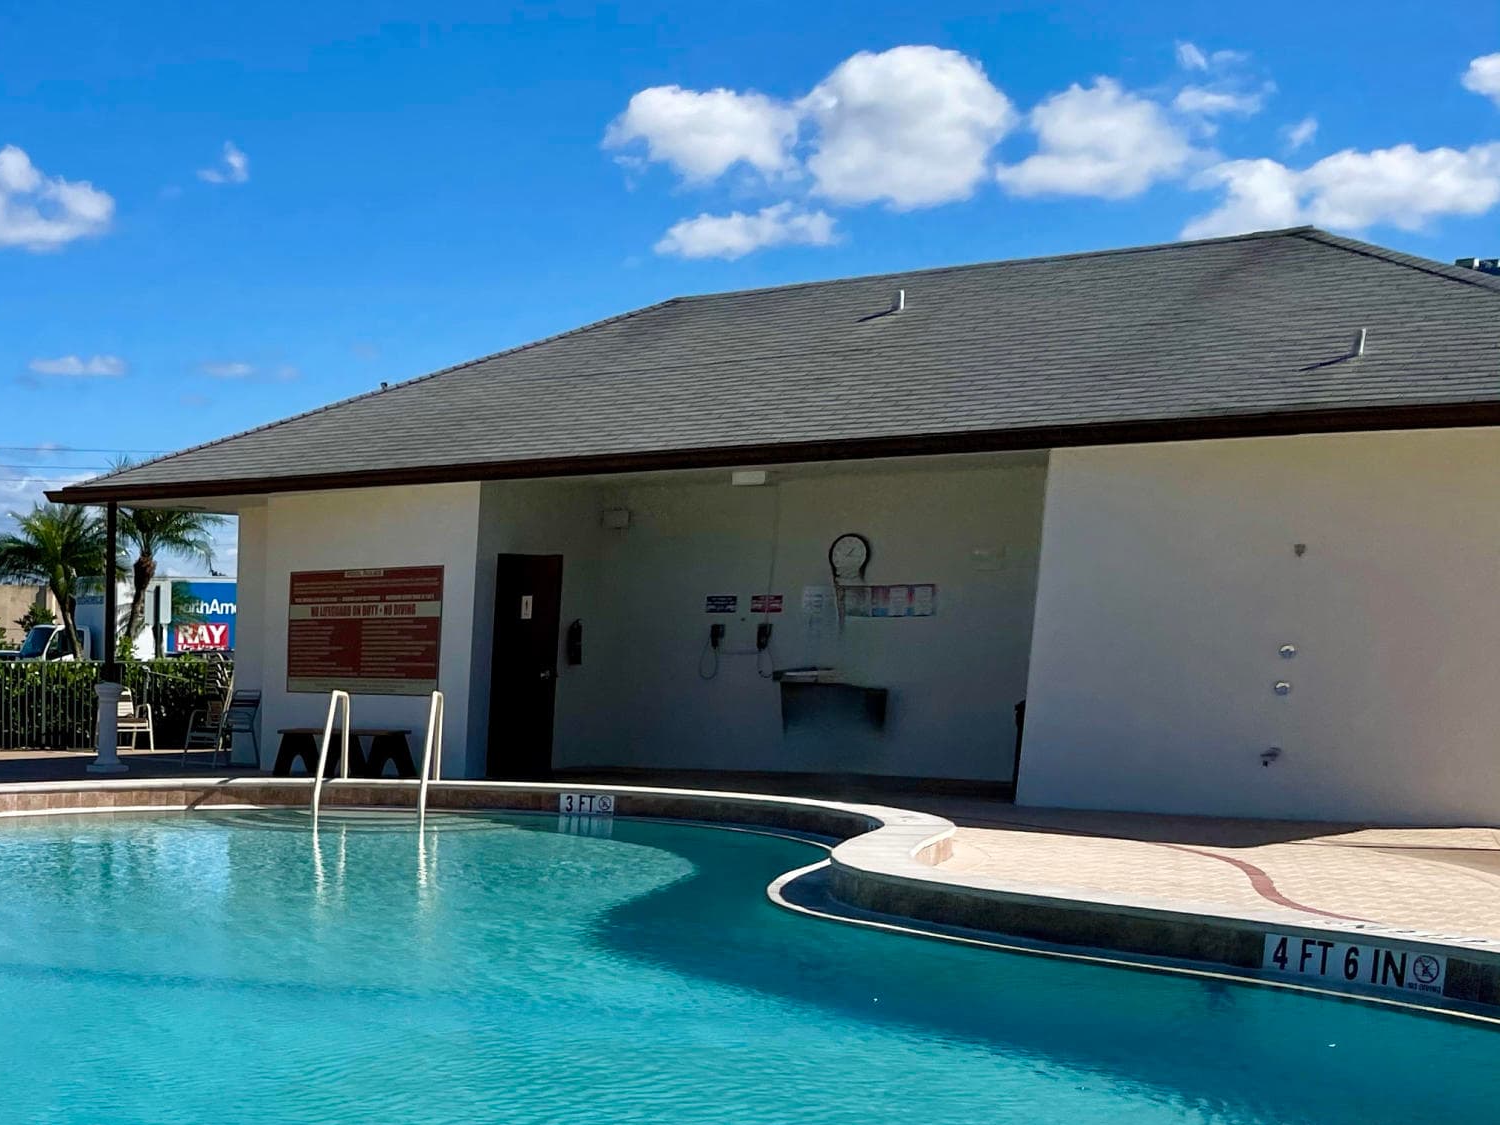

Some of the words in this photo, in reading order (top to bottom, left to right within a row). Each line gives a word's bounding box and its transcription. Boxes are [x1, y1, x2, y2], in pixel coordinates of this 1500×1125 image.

[178, 625, 226, 644] RAY
[565, 795, 573, 812] 3
[579, 794, 596, 812] FT
[1273, 936, 1288, 970] 4
[1299, 938, 1334, 976] FT
[1344, 946, 1359, 981] 6
[1370, 948, 1407, 988] IN
